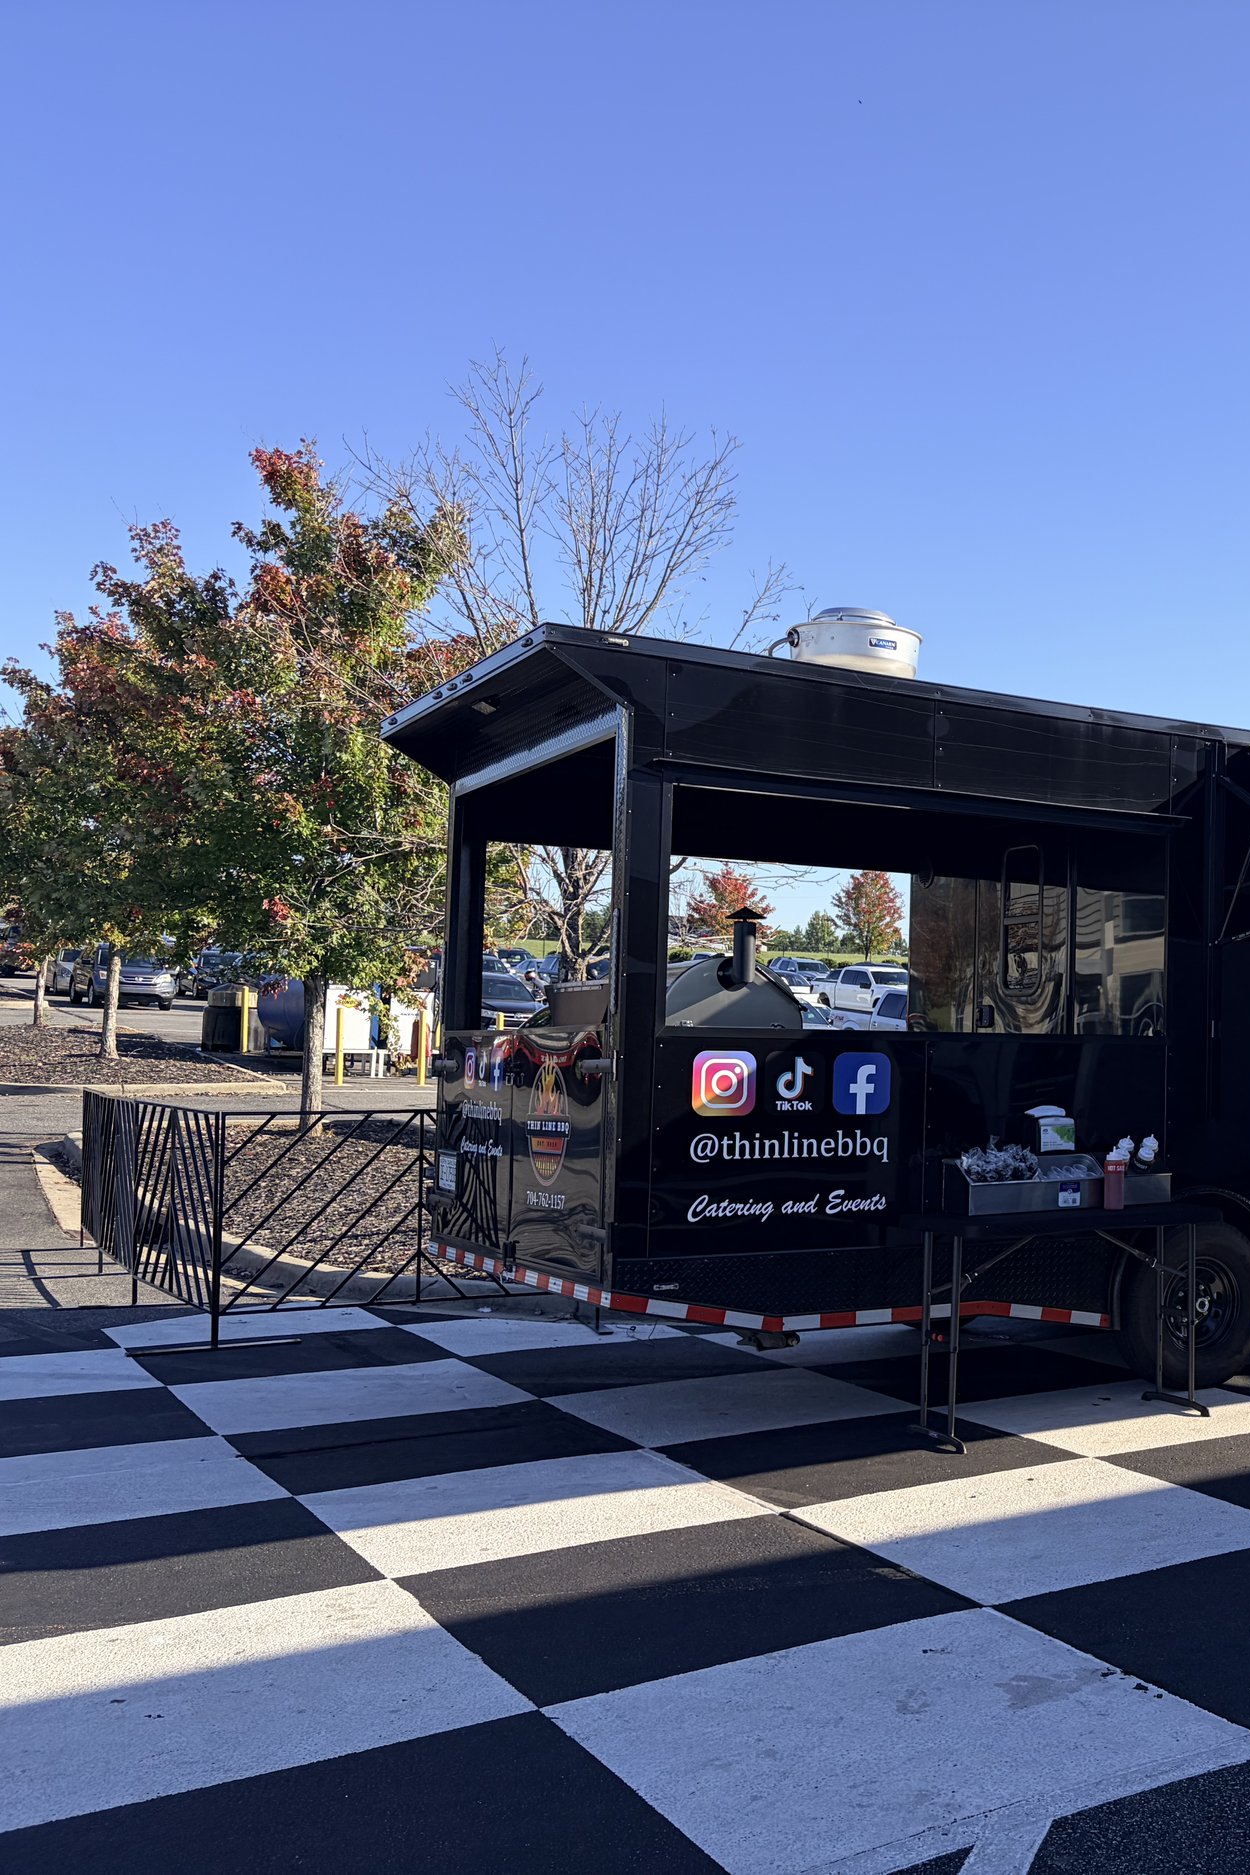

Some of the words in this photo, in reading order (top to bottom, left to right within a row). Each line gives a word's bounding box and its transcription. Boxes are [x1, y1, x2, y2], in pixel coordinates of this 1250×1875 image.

[462, 1099, 503, 1127] @thinlinebbq
[775, 1100, 813, 1111] TikTok
[527, 1120, 541, 1130] THIN
[542, 1121, 556, 1131] LINE
[557, 1122, 570, 1134] BBQ
[460, 1135, 478, 1158] Catering
[478, 1140, 488, 1154] and
[487, 1139, 503, 1157] Events
[689, 1129, 889, 1163] @thinlinebbq
[526, 1190, 565, 1210] 704-762-1157
[687, 1194, 774, 1222] Catering
[781, 1193, 820, 1214] and
[825, 1189, 887, 1215] Events
